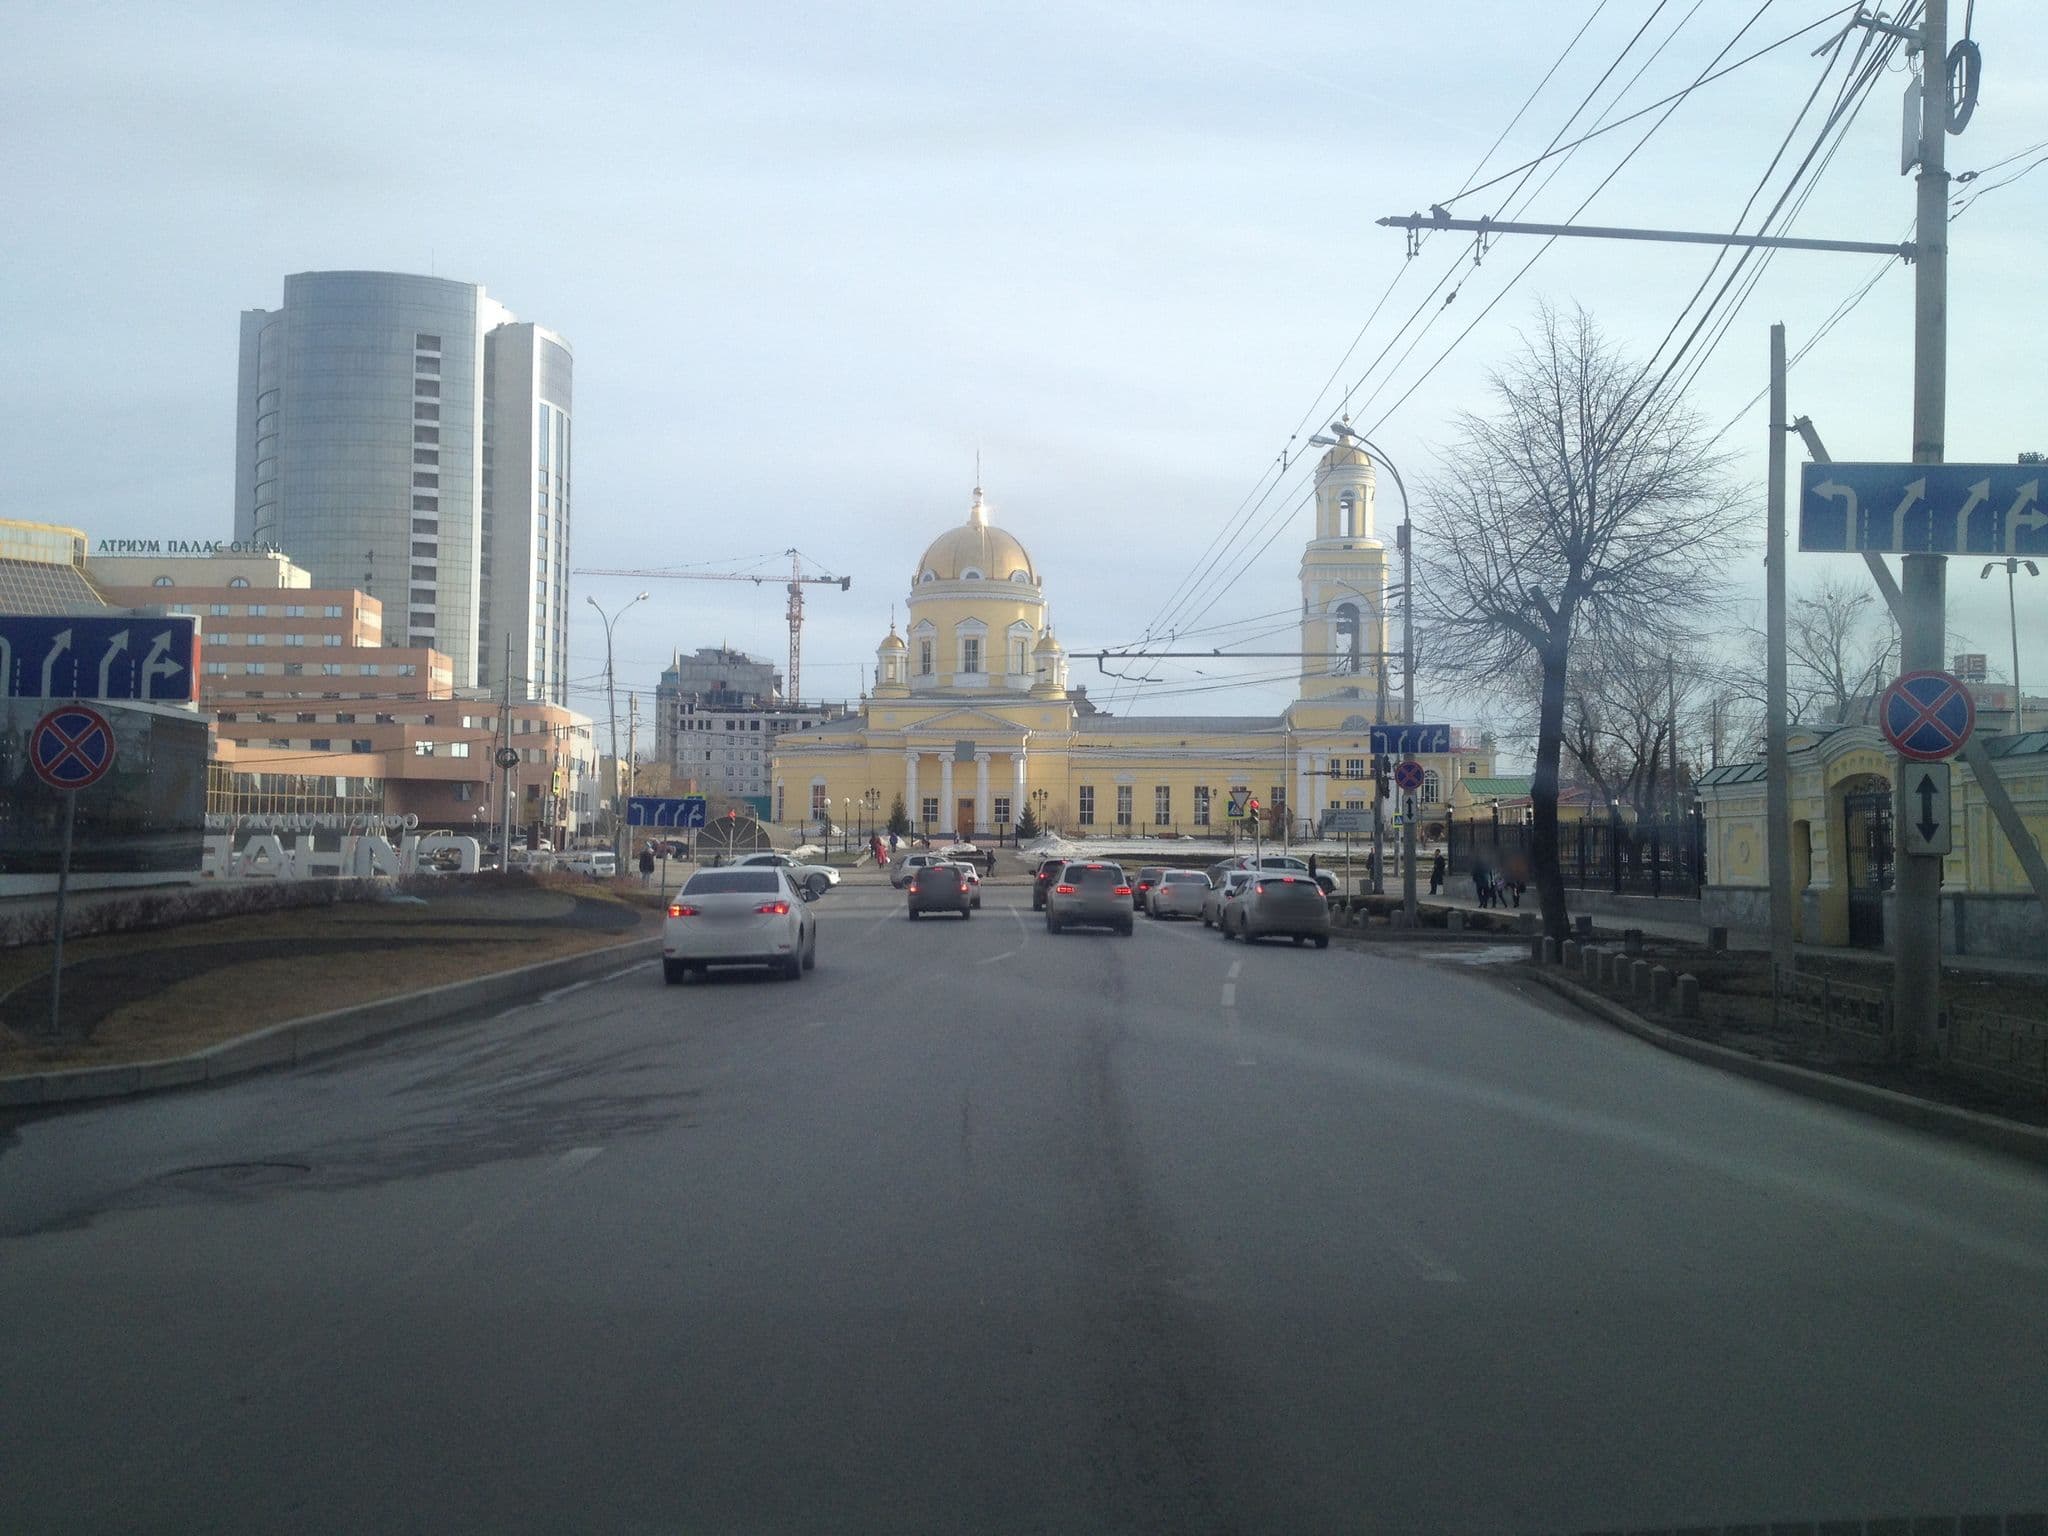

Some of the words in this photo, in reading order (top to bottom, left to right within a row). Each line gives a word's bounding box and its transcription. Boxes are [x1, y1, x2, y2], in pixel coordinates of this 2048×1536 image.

[98, 540, 160, 552] АТРИУМ
[168, 540, 224, 553] ПАЛАС
[231, 541, 281, 553] ОТЕЛЬ
